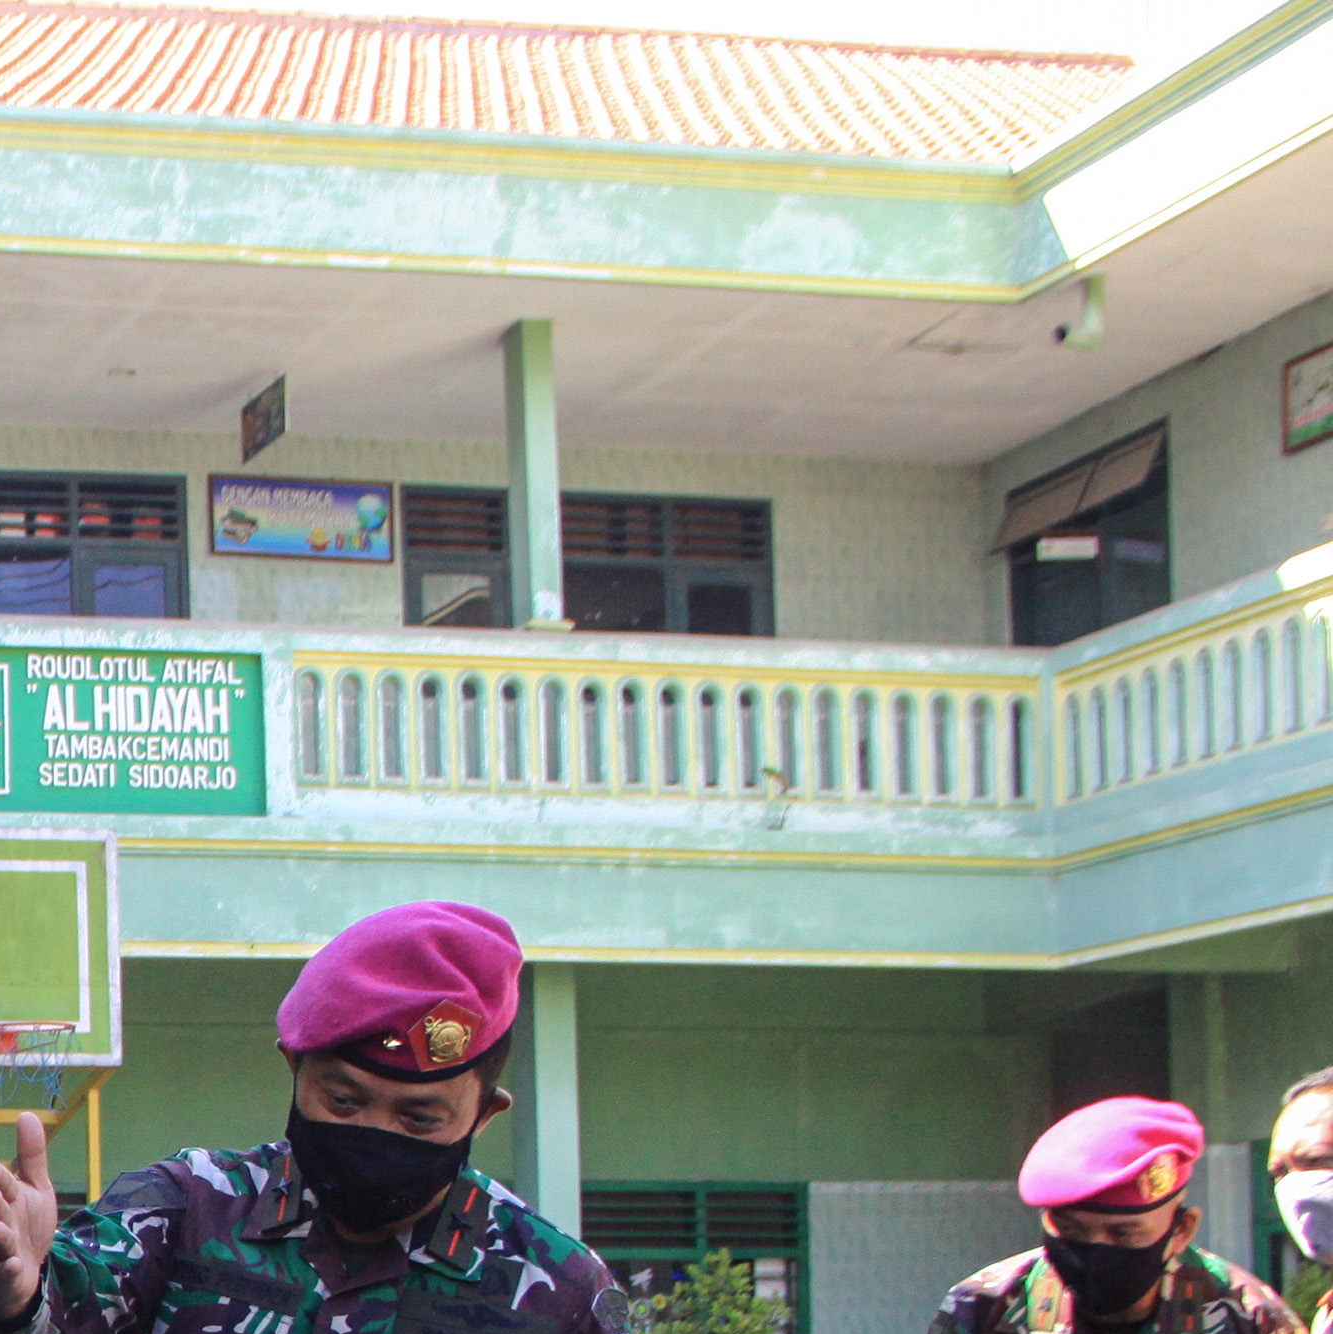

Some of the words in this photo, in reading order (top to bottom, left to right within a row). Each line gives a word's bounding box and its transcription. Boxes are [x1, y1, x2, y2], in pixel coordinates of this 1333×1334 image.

[26, 654, 156, 682] ROUDLOTUL
[162, 658, 244, 685] ATHFAL
[43, 734, 231, 762] TAMBAKCEMANDI
[38, 762, 117, 788] SEDATI
[128, 763, 238, 790] SIDOARJO
